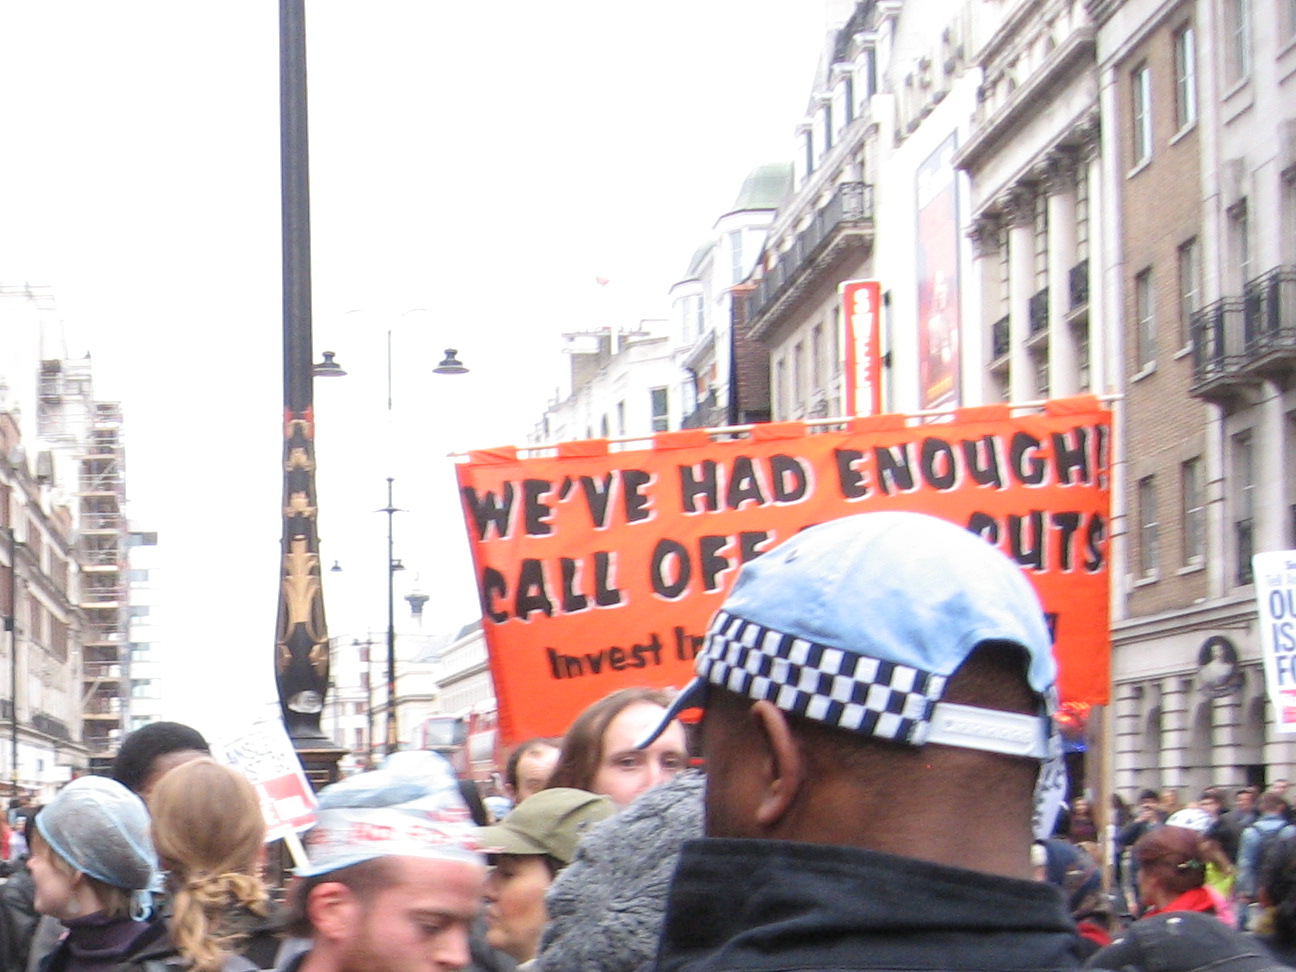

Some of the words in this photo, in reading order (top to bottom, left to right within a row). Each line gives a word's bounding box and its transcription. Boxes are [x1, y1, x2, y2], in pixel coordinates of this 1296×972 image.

[462, 468, 657, 542] WE'VE
[677, 453, 816, 516] HAD
[834, 424, 1109, 503] ENOUGH!
[482, 550, 630, 625] CALL
[546, 633, 662, 679] Invest
